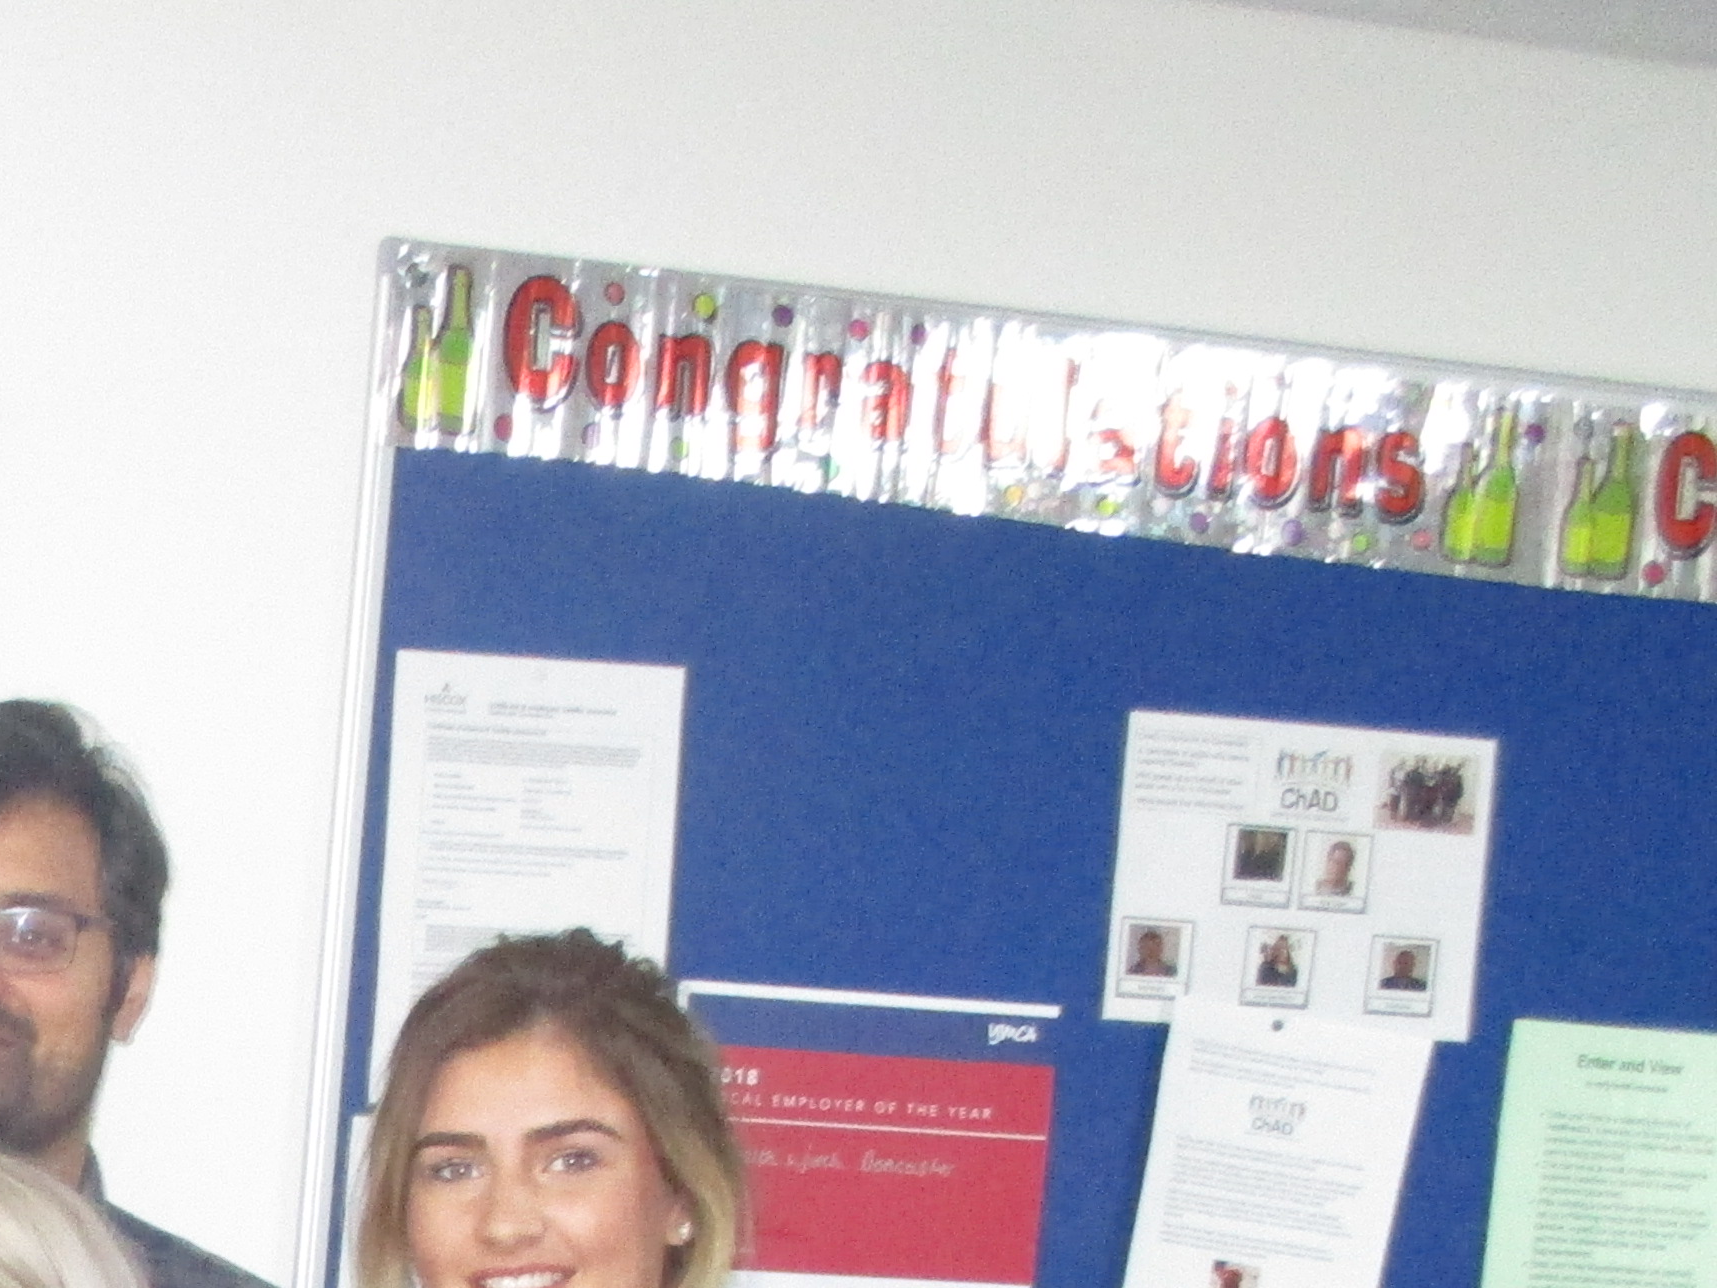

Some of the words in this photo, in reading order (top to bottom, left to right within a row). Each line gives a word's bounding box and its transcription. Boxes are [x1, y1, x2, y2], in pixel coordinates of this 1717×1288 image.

[718, 1066, 761, 1087] 018
[771, 1093, 866, 1112] EMPLOYER
[873, 1099, 896, 1116] OF
[906, 1101, 940, 1118] THE
[948, 1105, 994, 1121] YEAR
